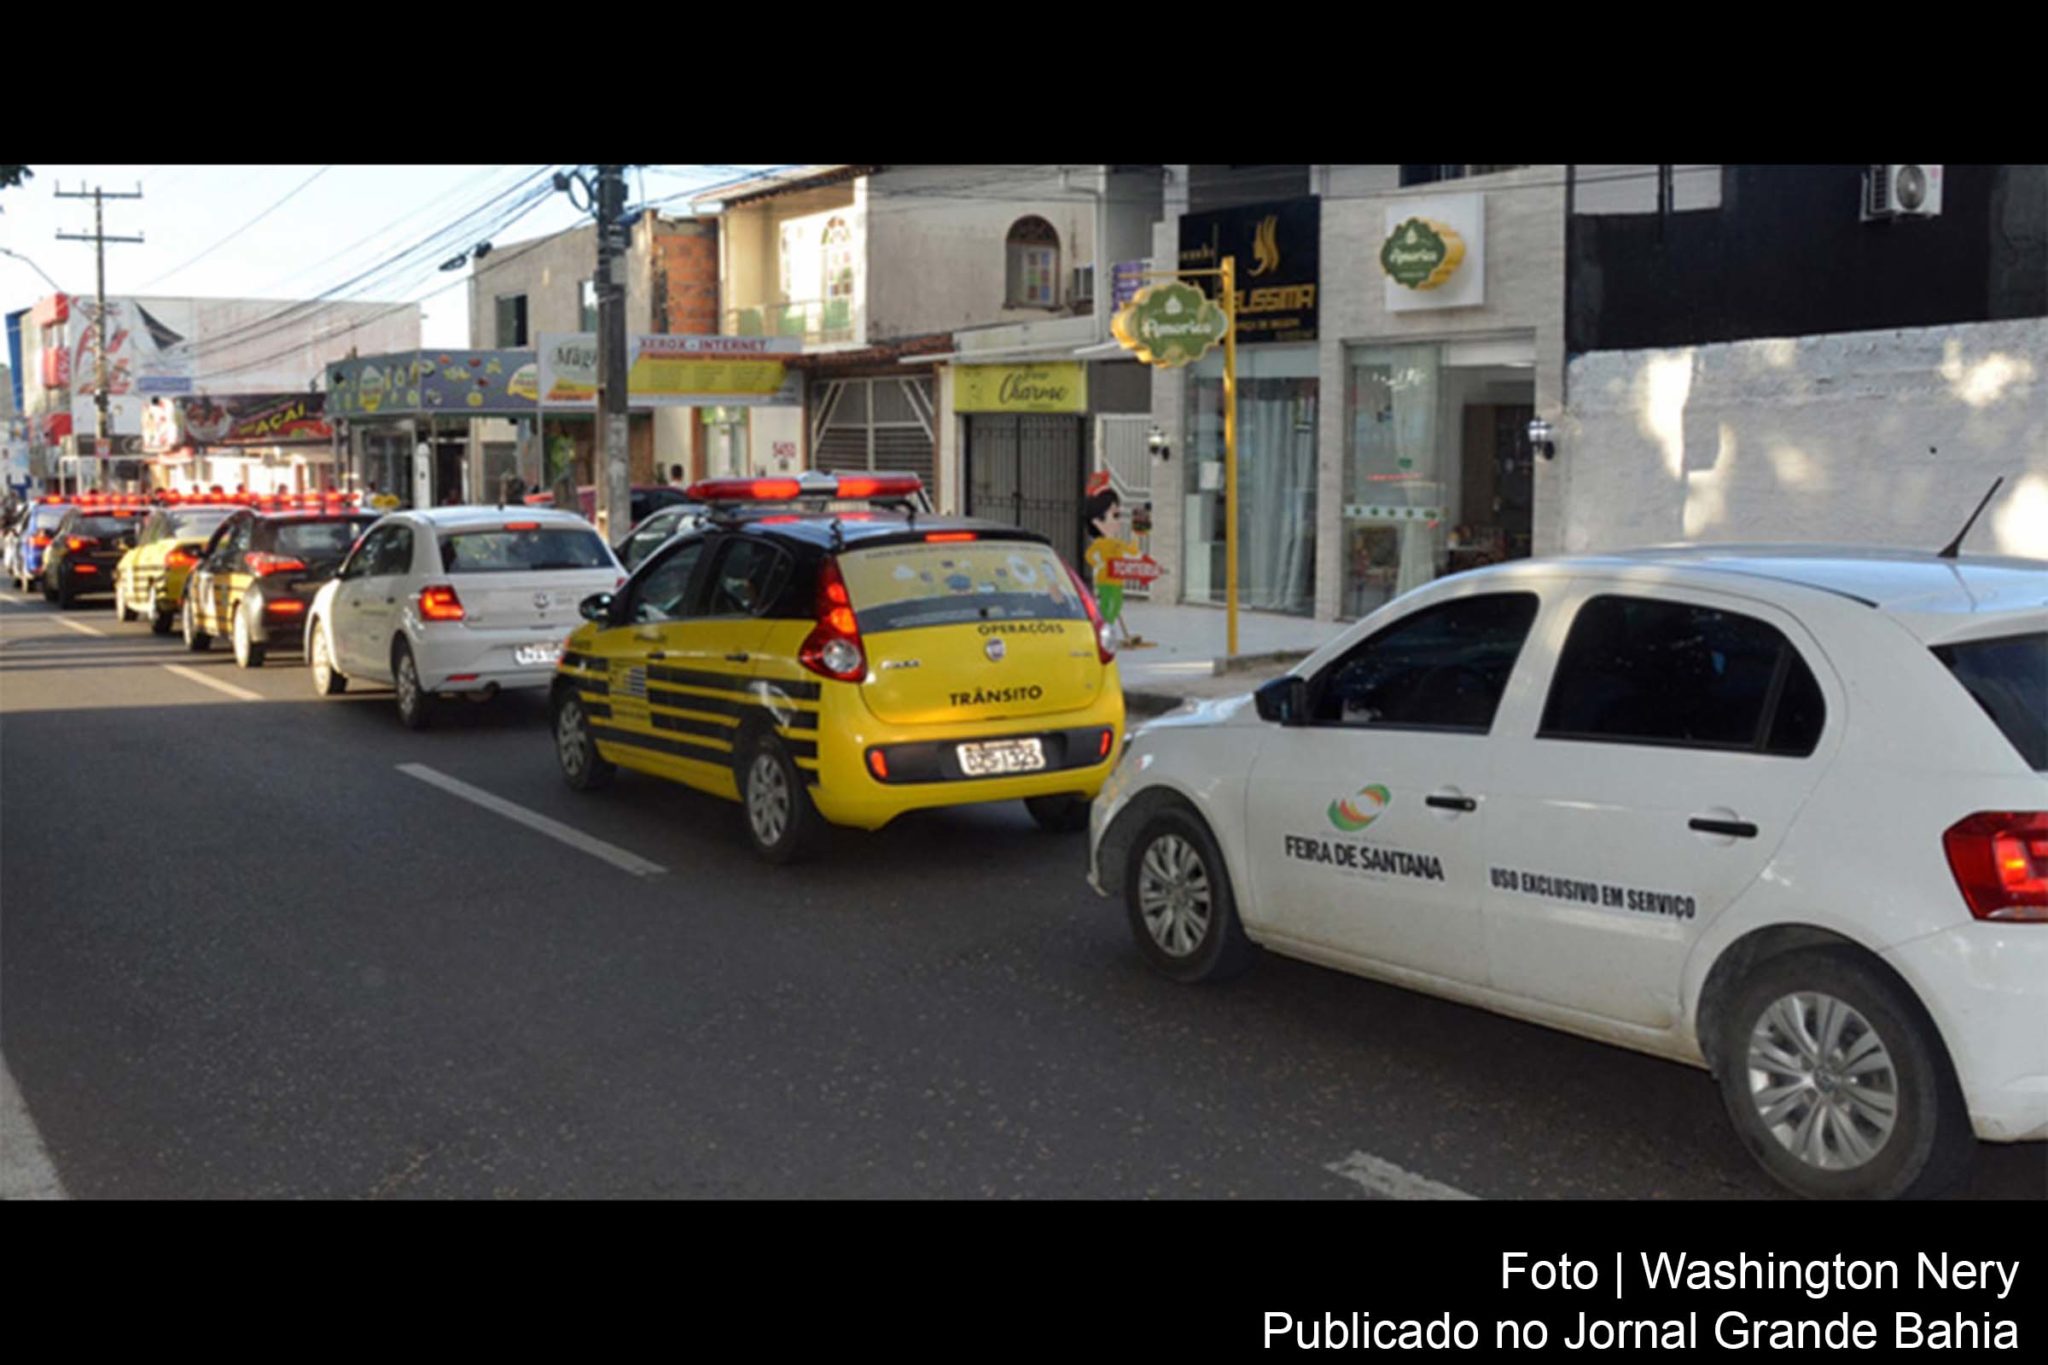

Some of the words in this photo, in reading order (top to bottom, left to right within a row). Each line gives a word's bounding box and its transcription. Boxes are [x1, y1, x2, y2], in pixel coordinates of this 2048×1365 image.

[640, 339, 686, 350] XEROX
[700, 339, 767, 350] INTERNET
[978, 620, 1065, 636] OPERAÇÕES
[949, 685, 1043, 706] TRÂNSITO
[1285, 835, 1332, 864] FEIRA
[1333, 843, 1357, 868] DE
[1360, 847, 1444, 881] SANTANA
[1491, 867, 1519, 890] USO
[1521, 873, 1599, 904] EXCLUSIVO
[1601, 885, 1624, 908] EM
[1627, 889, 1696, 921] SERVIÇO
